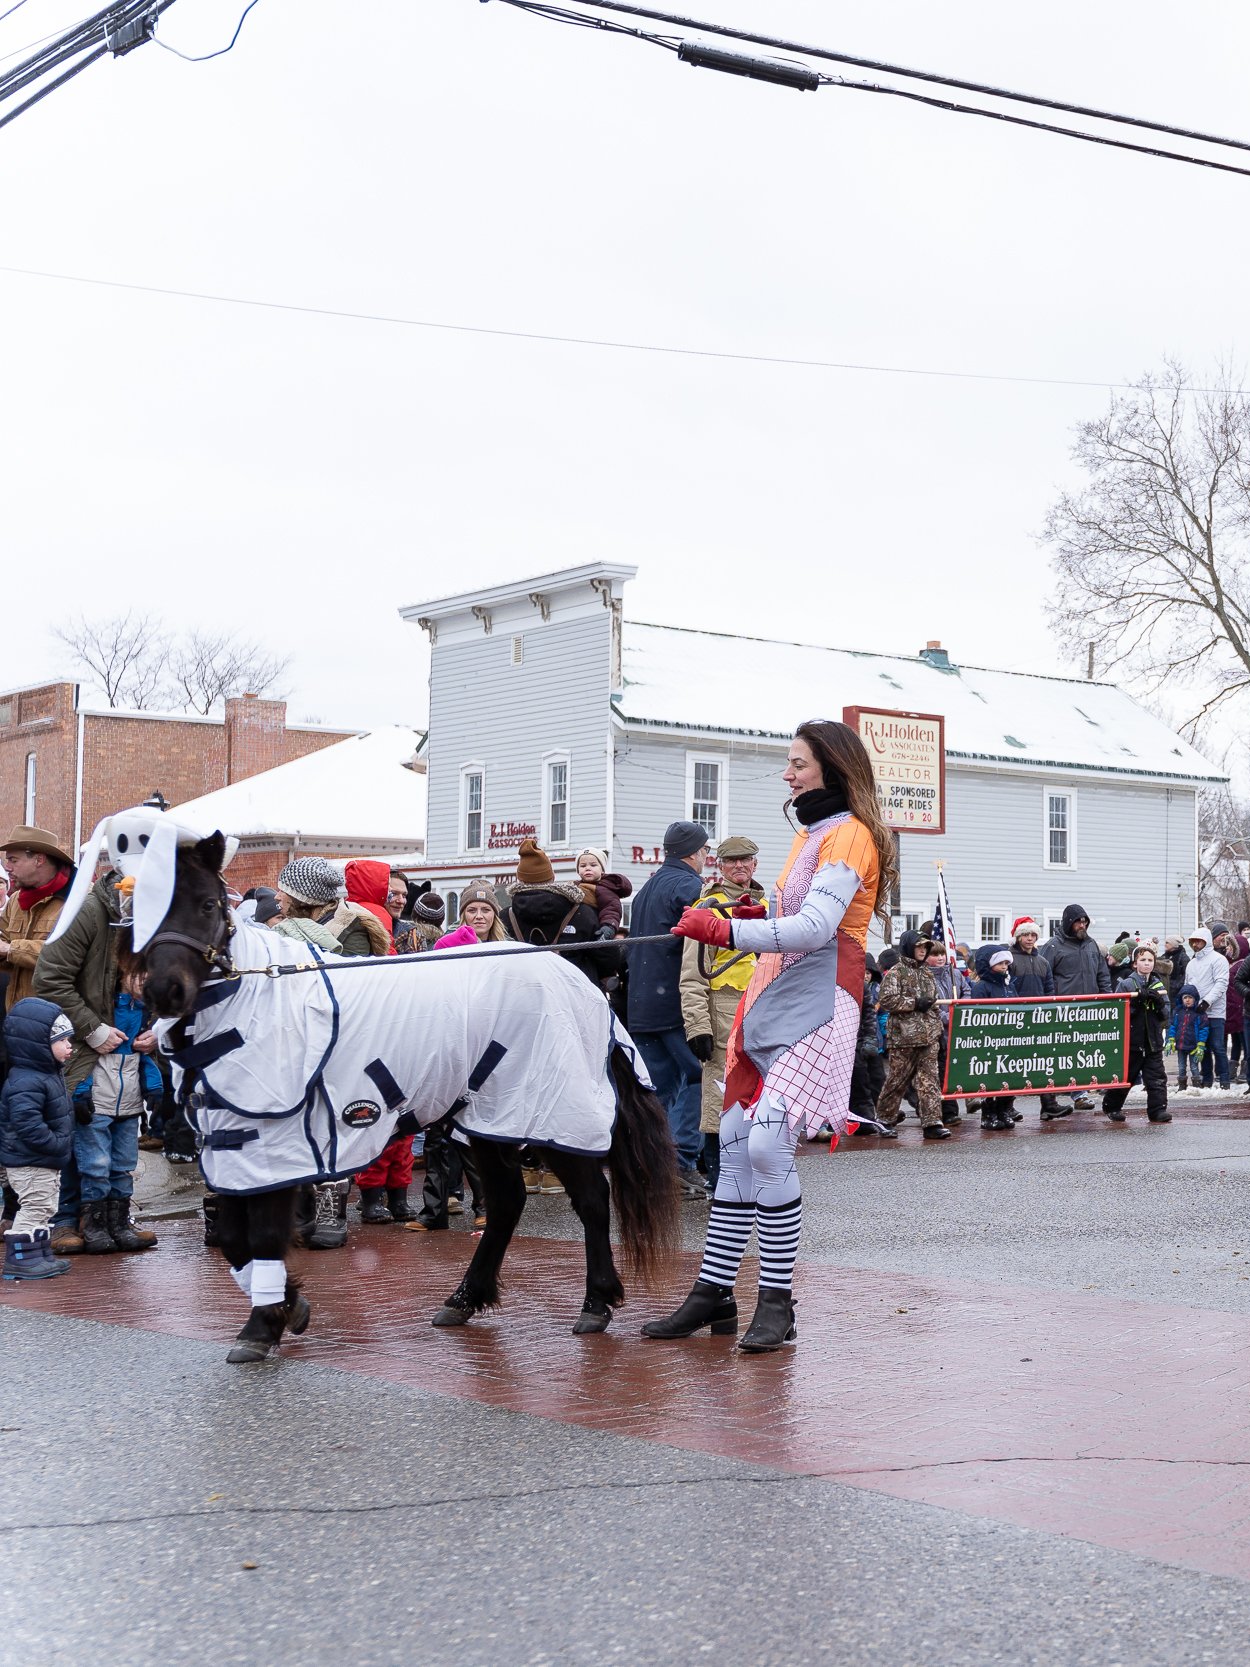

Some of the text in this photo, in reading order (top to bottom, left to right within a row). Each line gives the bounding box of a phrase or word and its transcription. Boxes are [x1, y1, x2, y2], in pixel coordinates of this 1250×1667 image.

[890, 742, 935, 752] ASSOCIATES
[892, 752, 930, 761] 678-2246
[890, 786, 935, 798] SPONSORED
[909, 800, 933, 810] RIDES
[904, 812, 914, 821] 19
[922, 813, 932, 822] 20
[959, 1005, 1119, 1029] Honoring the Metamora
[955, 1030, 1120, 1050] Police Department and Fire Department
[969, 1049, 1106, 1077] for Keeping us Safe
